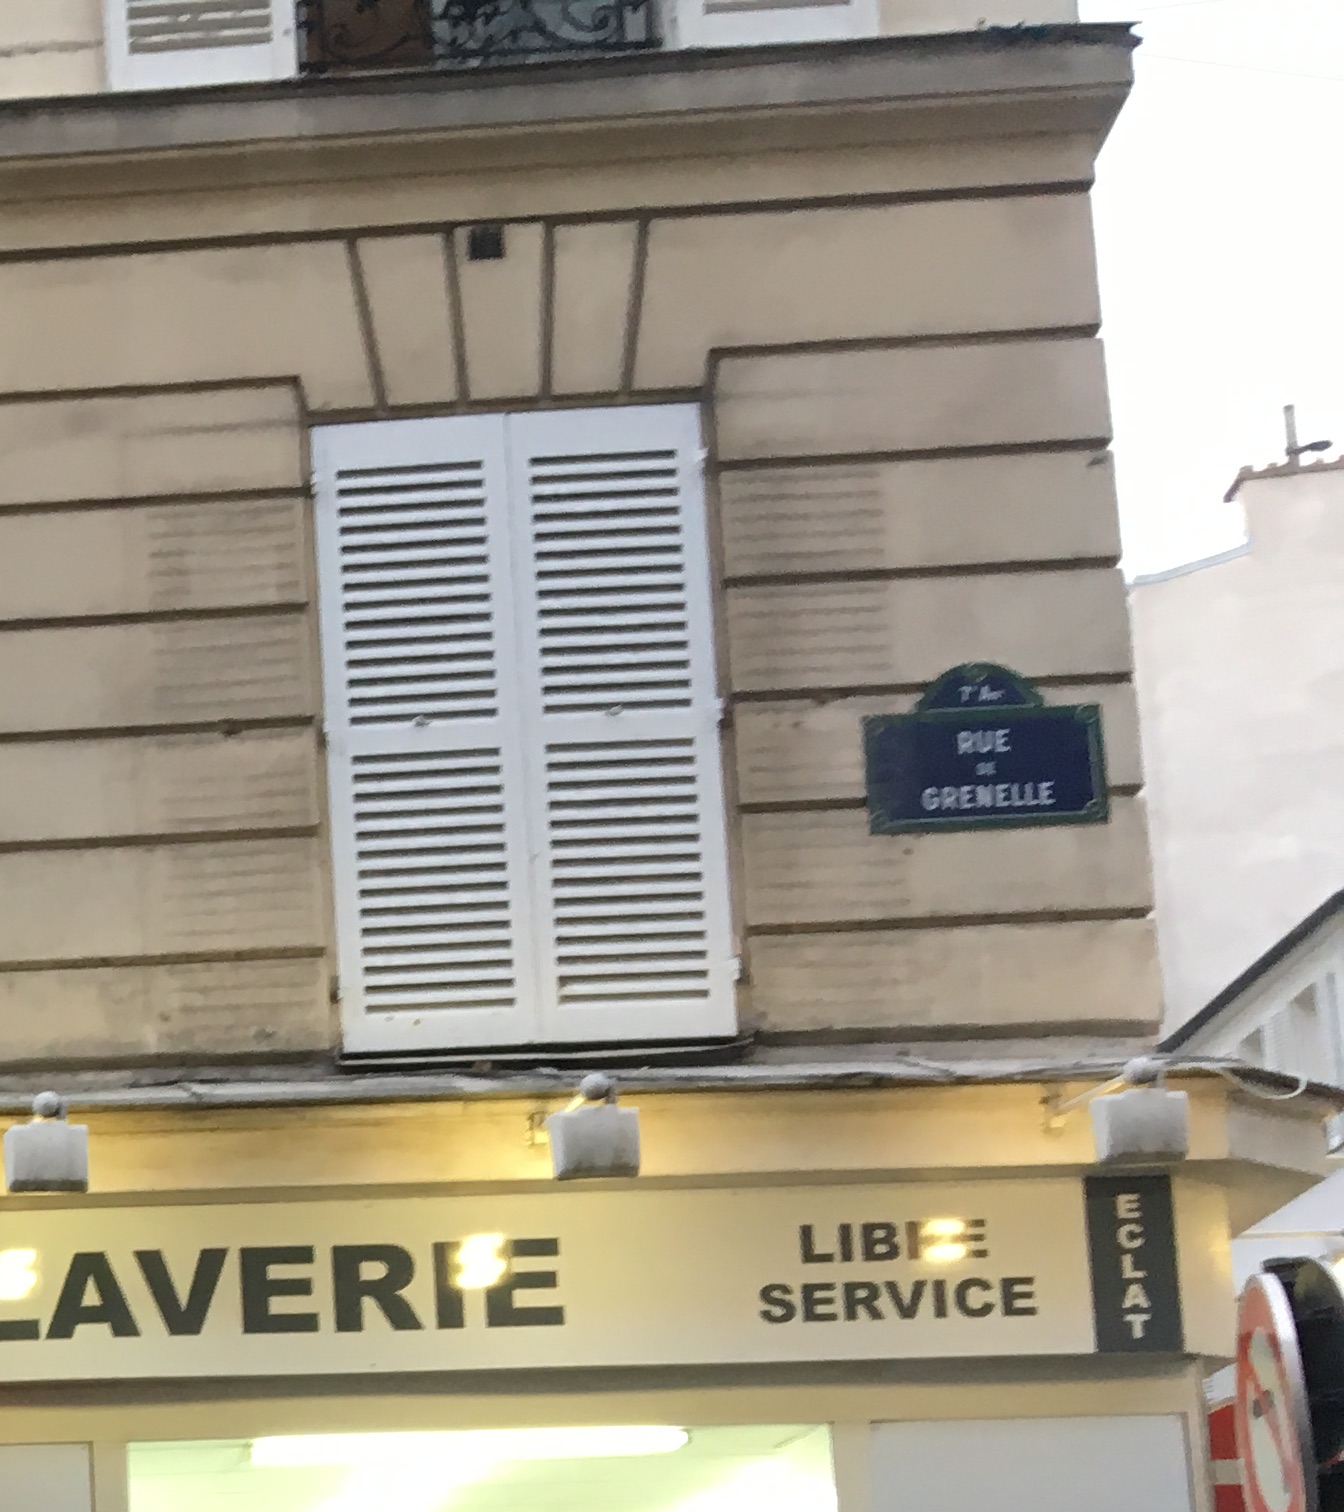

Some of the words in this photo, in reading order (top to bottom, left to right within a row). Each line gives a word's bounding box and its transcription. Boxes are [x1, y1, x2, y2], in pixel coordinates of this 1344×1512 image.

[957, 729, 1011, 754] RUE
[922, 782, 1055, 810] GRENELLE
[1117, 1194, 1151, 1339] ECLAT
[760, 1277, 1037, 1324] SERVICE
